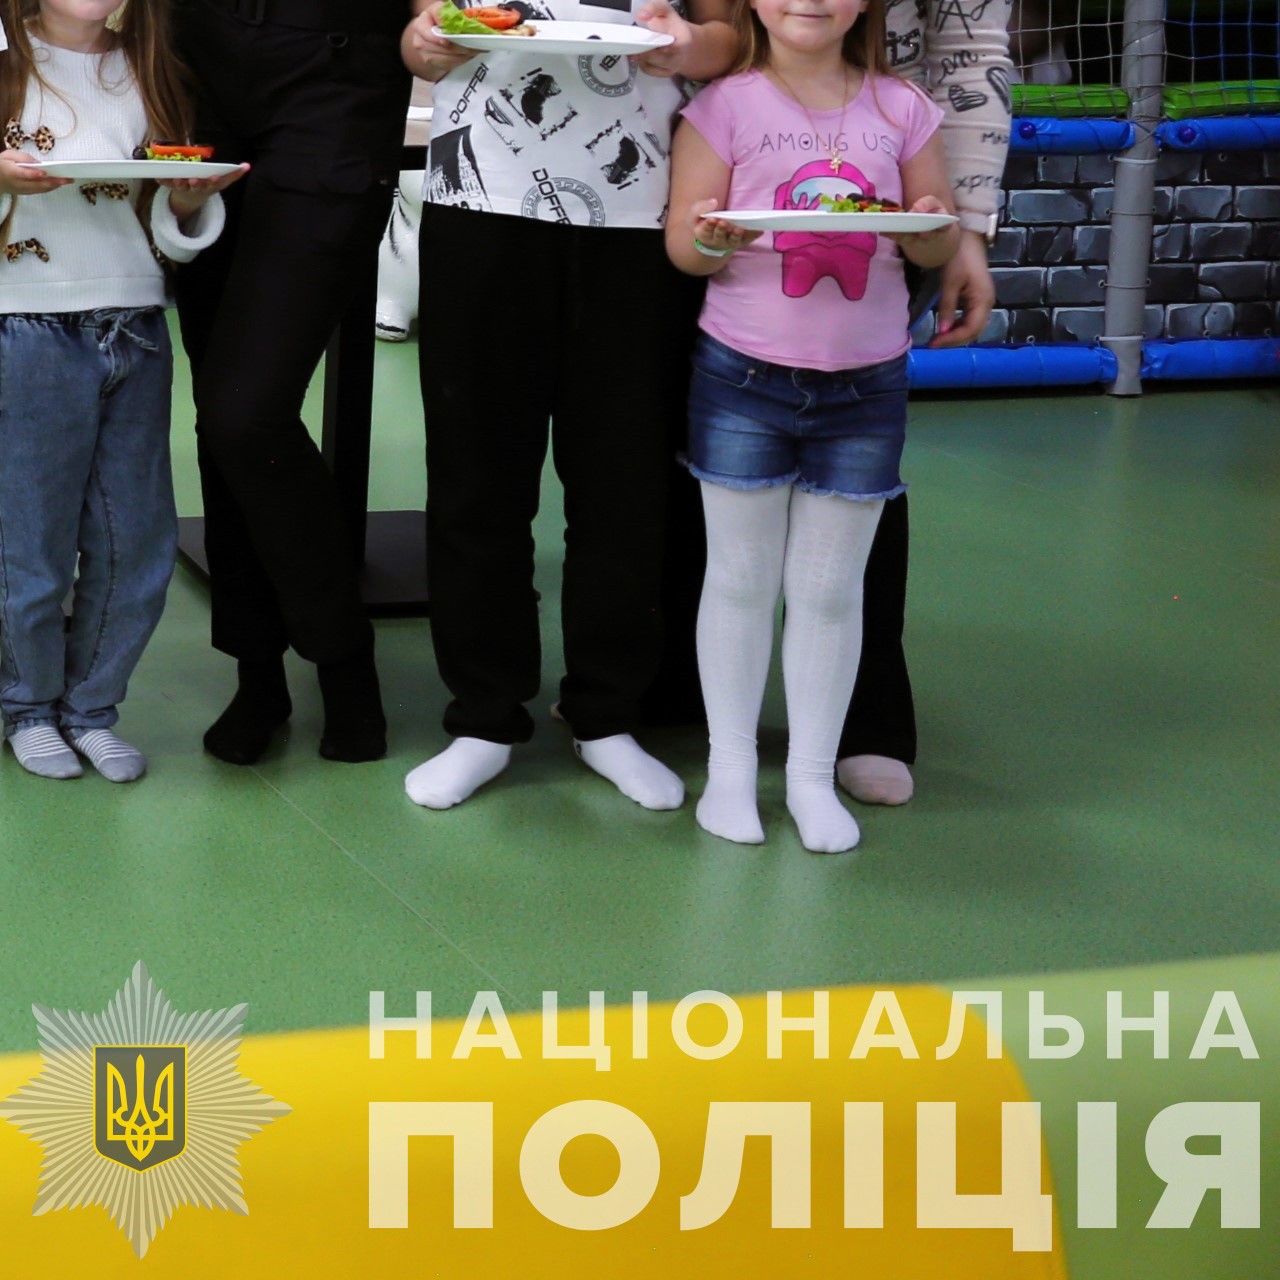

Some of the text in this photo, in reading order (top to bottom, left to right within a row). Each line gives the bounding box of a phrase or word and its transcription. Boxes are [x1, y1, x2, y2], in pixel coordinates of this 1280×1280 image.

[449, 62, 488, 125] DOFFBI
[759, 131, 896, 155] AMONG US
